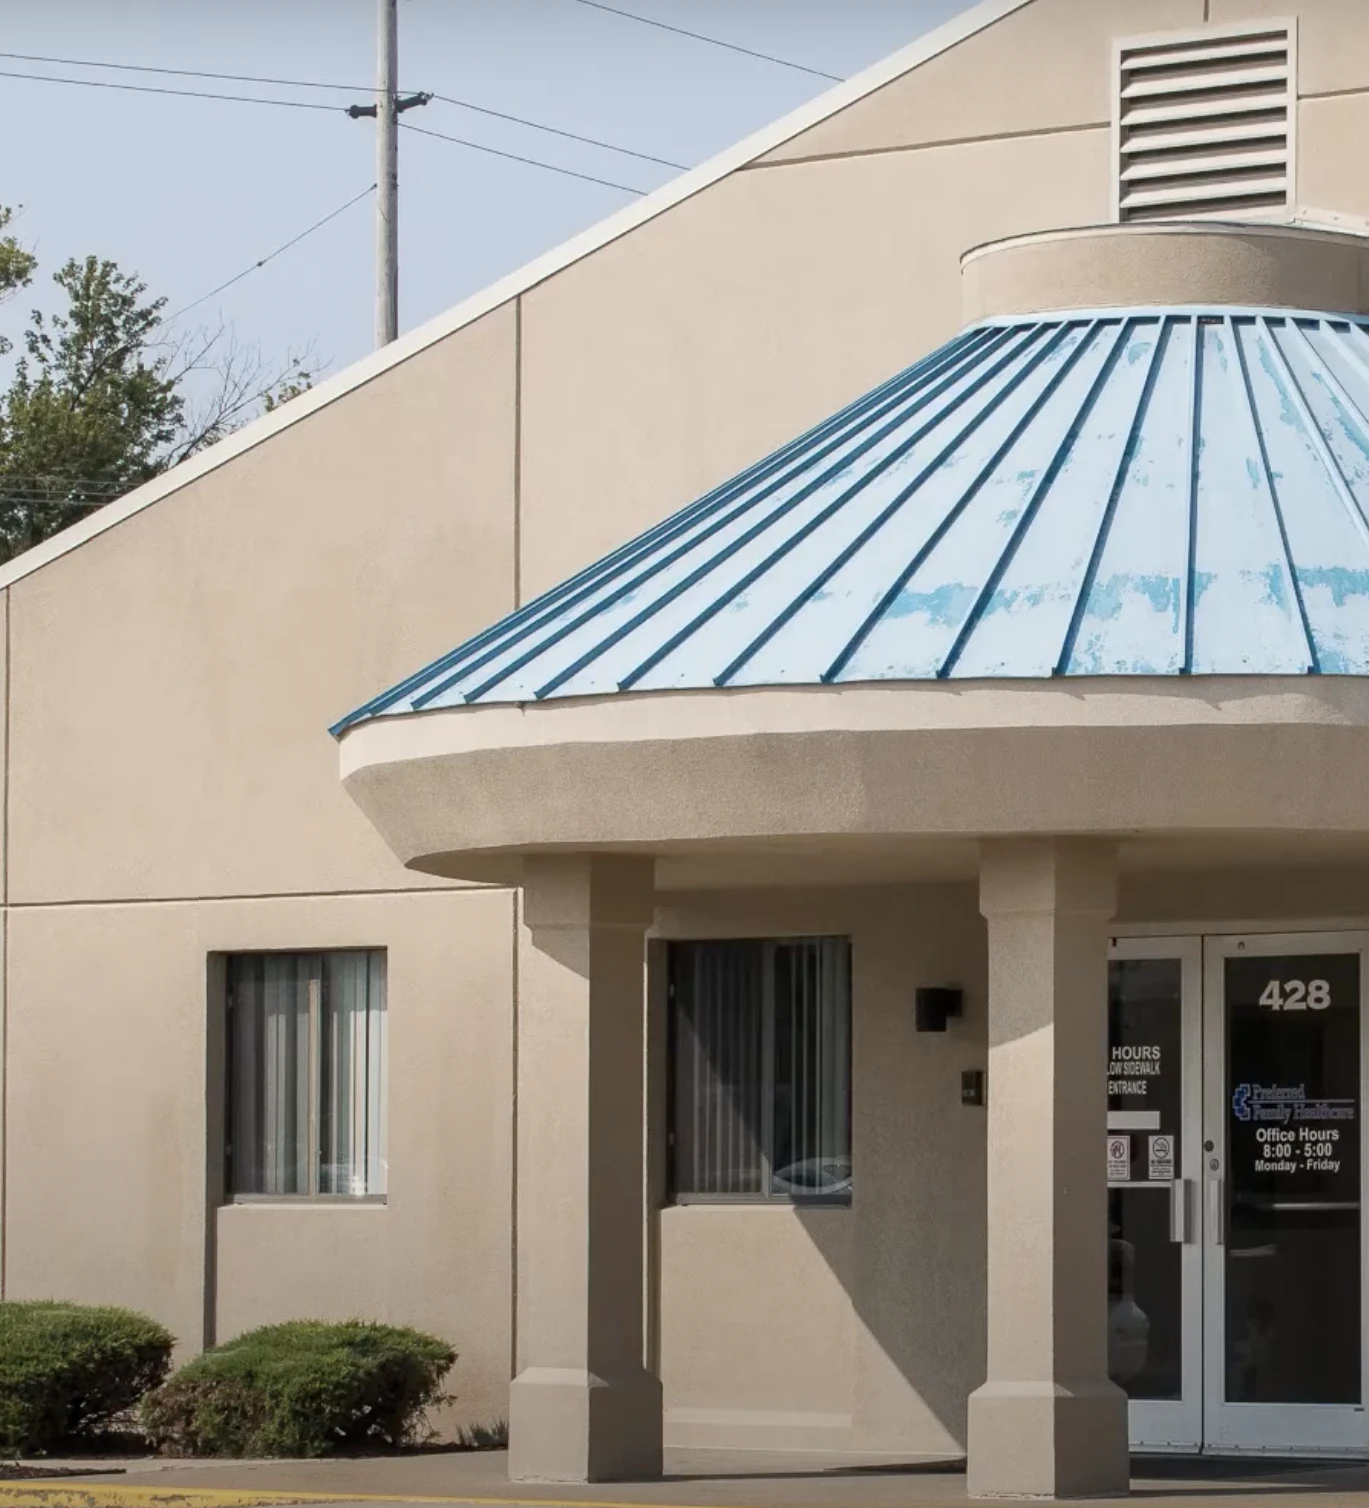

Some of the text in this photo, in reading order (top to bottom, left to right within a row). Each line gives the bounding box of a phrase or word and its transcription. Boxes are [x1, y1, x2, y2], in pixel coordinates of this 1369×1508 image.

[1259, 979, 1331, 1011] 428
[1112, 1046, 1161, 1060] HOURS
[1123, 1061, 1161, 1076] SIDEWALK
[1108, 1080, 1148, 1095] ENTRANCE
[1252, 1083, 1306, 1100] Preferred
[1252, 1103, 1355, 1125] Family Healthcare
[1256, 1127, 1340, 1142] Office Hours
[1263, 1143, 1292, 1158] 8:00
[1303, 1142, 1333, 1158] 5:00
[1255, 1159, 1297, 1174] Monday
[1306, 1158, 1341, 1173] Friday
